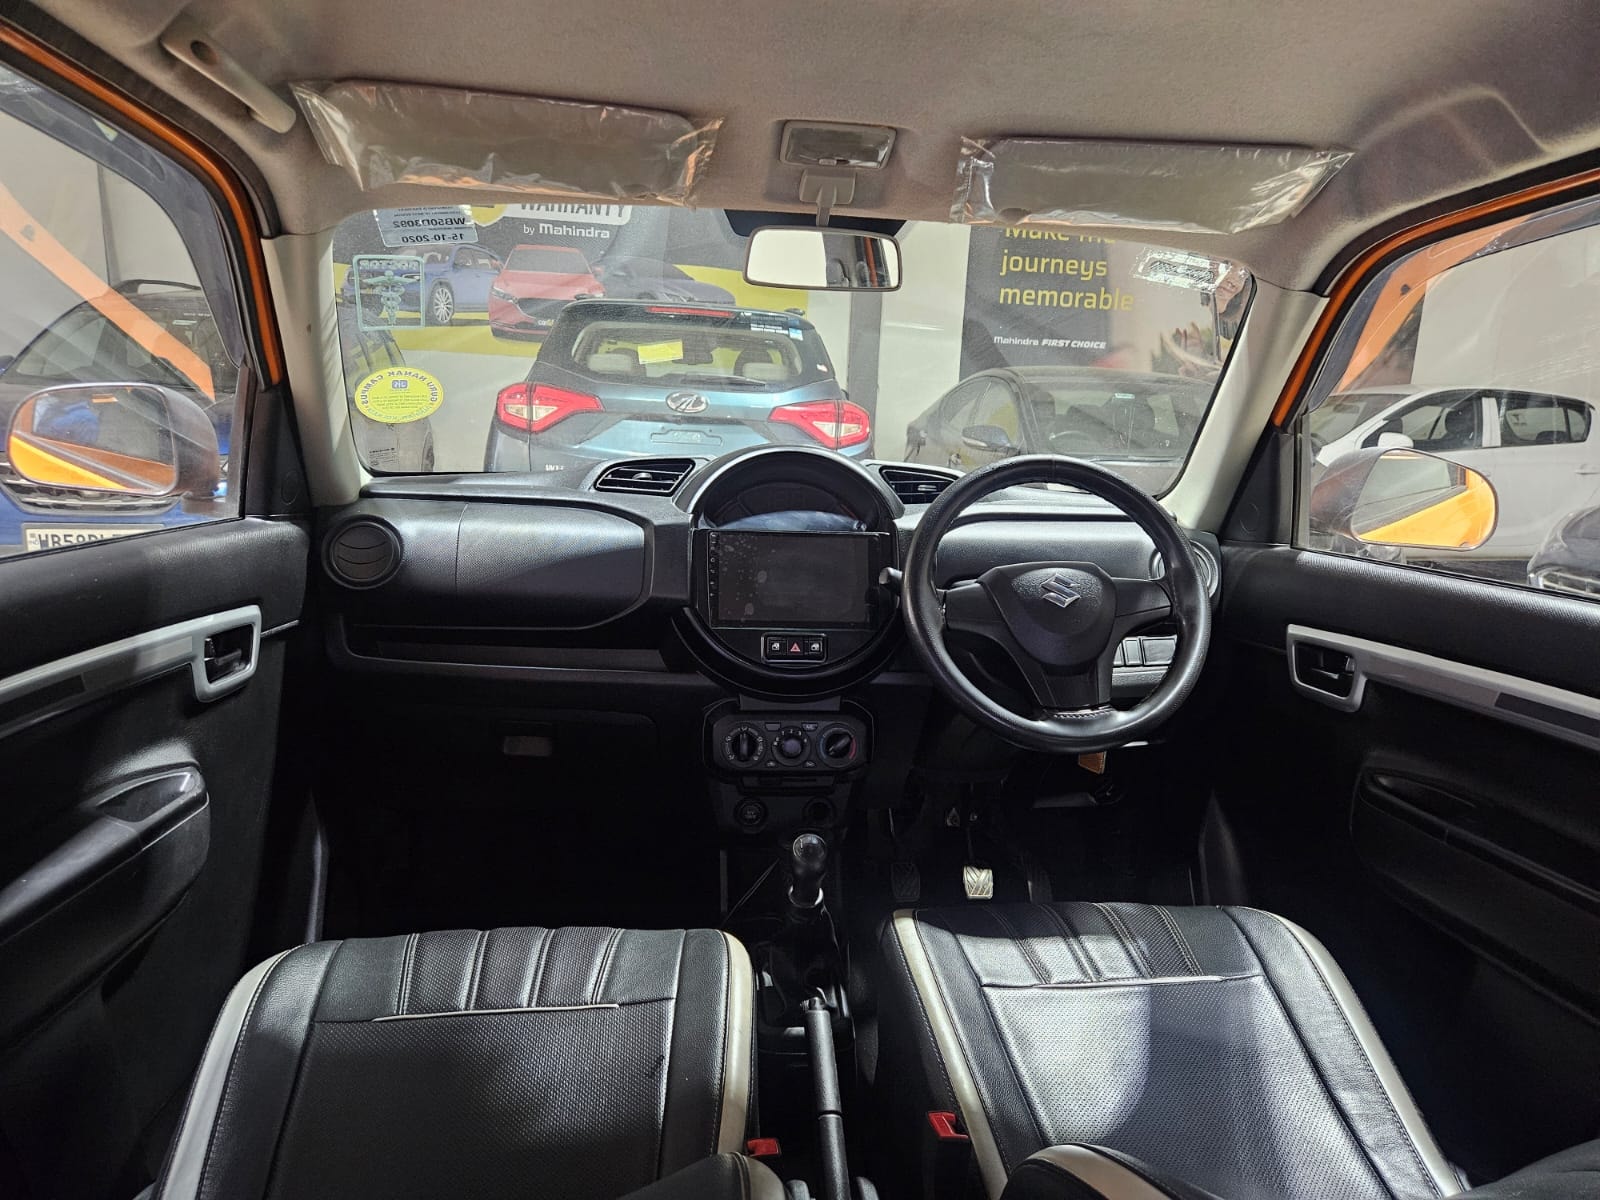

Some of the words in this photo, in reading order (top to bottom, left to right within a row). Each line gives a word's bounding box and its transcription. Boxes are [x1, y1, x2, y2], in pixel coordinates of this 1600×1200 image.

[523, 223, 535, 235] by
[539, 223, 610, 239] Mahindra
[1000, 248, 1107, 281] journeys
[999, 286, 1135, 312] memorable
[994, 336, 1039, 346] Mahindra
[1041, 338, 1071, 347] FIRST
[1070, 340, 1107, 350] CHOICE
